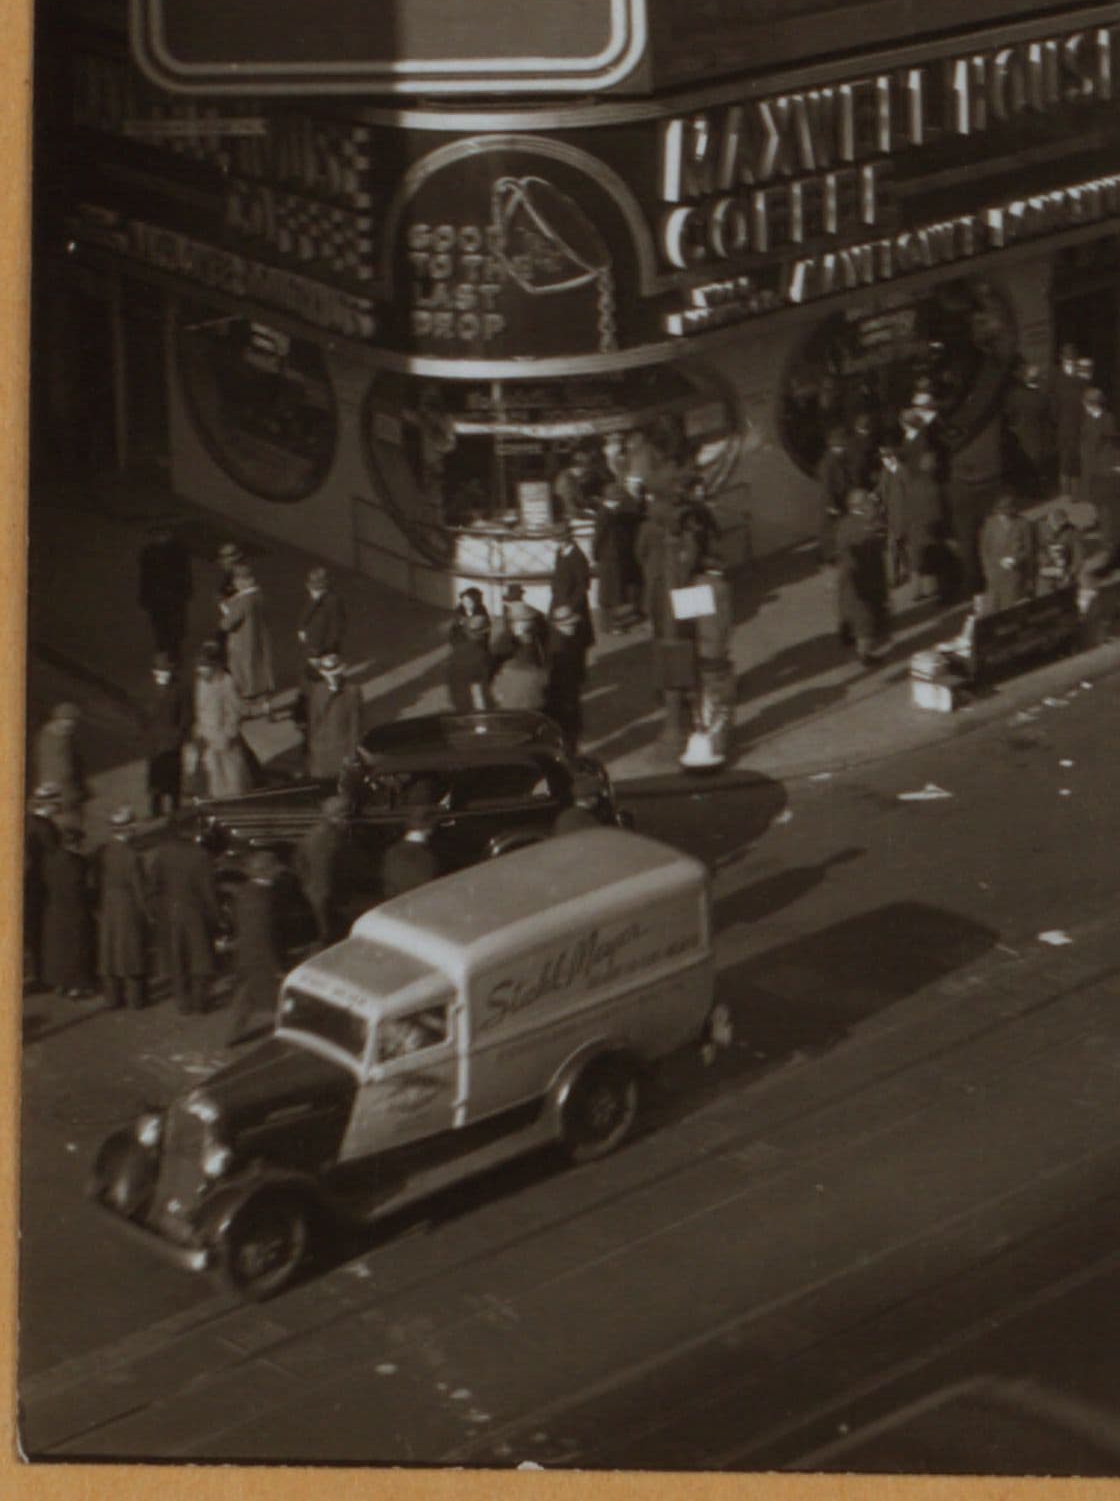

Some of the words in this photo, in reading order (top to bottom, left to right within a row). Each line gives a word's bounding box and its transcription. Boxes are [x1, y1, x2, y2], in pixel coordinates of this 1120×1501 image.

[408, 252, 453, 280] TO
[414, 281, 502, 311] LAST
[411, 310, 507, 342] DROP
